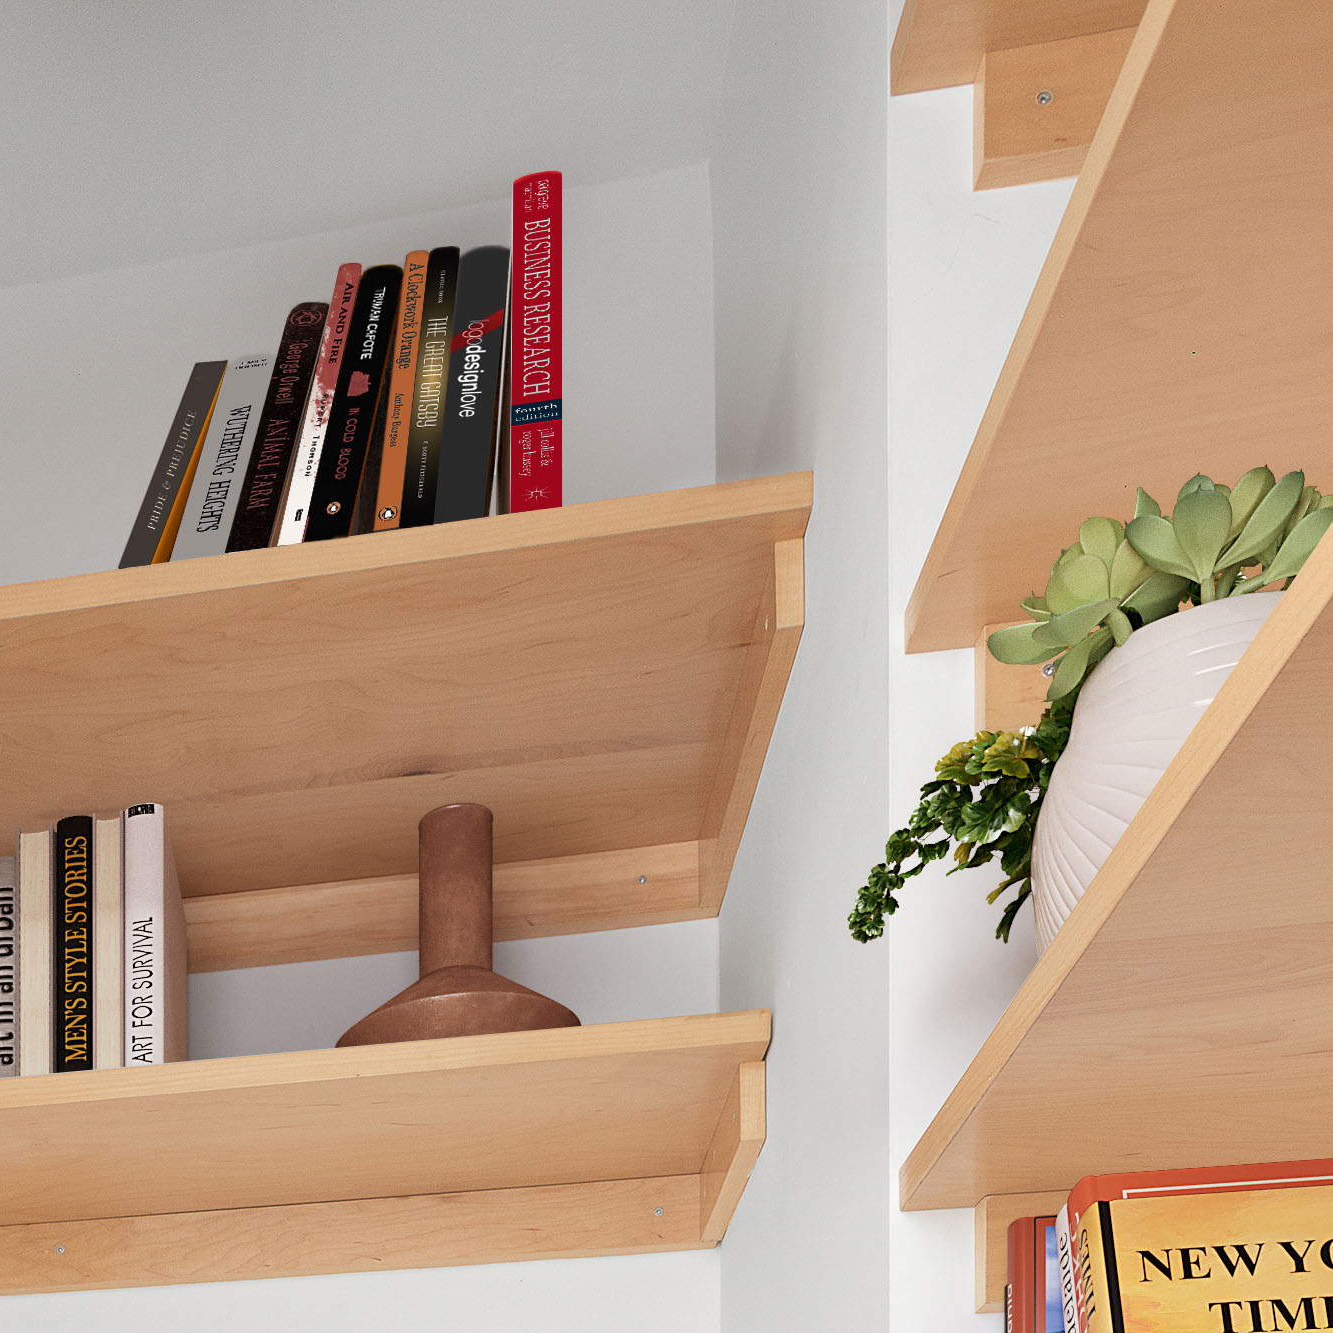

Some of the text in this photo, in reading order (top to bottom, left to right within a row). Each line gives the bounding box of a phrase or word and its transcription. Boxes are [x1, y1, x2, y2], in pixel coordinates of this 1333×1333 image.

[523, 217, 551, 300] BUSINESS
[328, 282, 355, 365] AIR AND FIRE
[395, 262, 425, 370] A Clockwork Orange
[523, 302, 551, 397] RESEARCH
[274, 342, 309, 404] George Orwell
[416, 315, 449, 428] THE GREAT GATSBY
[514, 403, 558, 413] fourth
[212, 404, 252, 476] WUTHERING
[342, 418, 358, 443] COLD
[389, 393, 405, 448] Anthony Burgess
[515, 412, 558, 422] edition
[147, 493, 166, 531] PRIDE
[166, 409, 197, 478] PREJUDICE
[246, 418, 292, 510] ANIMAL FARM
[304, 435, 321, 477] THOMSON
[334, 448, 352, 480] BLOOD
[196, 479, 232, 533] HEIGHTS
[64, 835, 88, 1064] MEN'S STYLE STORIES
[132, 916, 153, 1063] ART FOR SURVIVAL
[1078, 1228, 1096, 1328] TIMES
[1136, 1242, 1265, 1282] NEW
